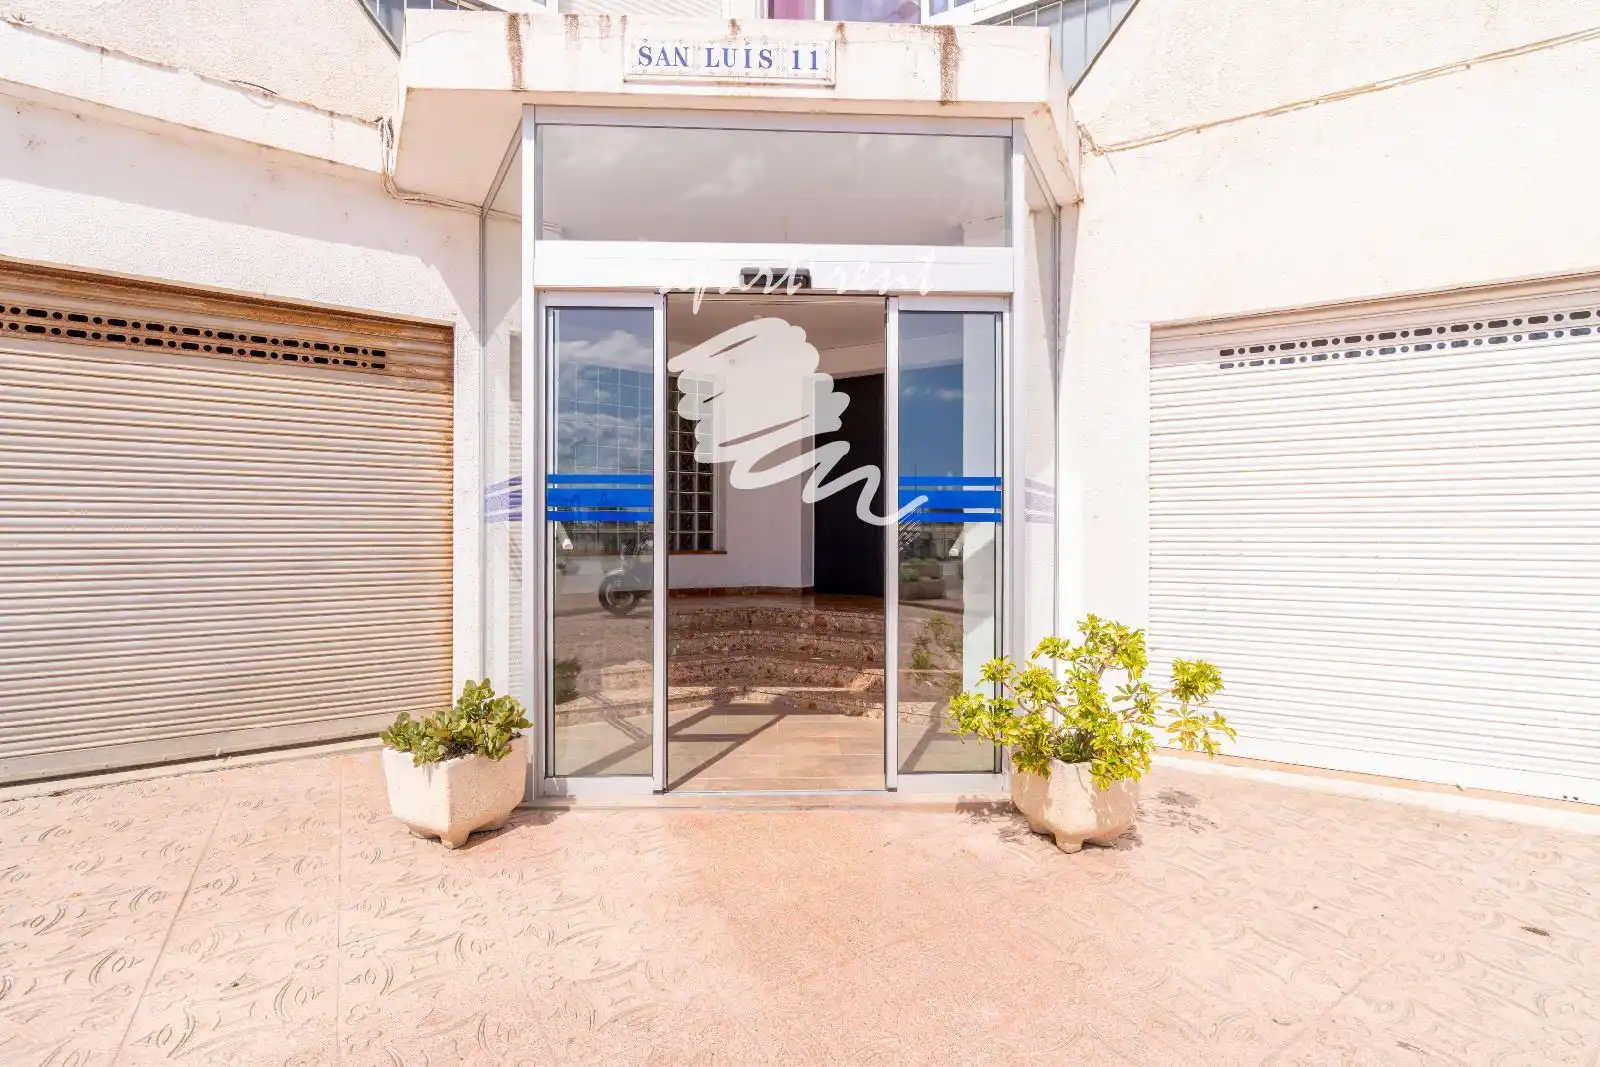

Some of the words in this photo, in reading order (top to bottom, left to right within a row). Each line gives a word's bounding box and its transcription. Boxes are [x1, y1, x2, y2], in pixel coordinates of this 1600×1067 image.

[638, 45, 689, 67] SAN
[705, 47, 773, 69] LUIS
[792, 49, 819, 70] 11
